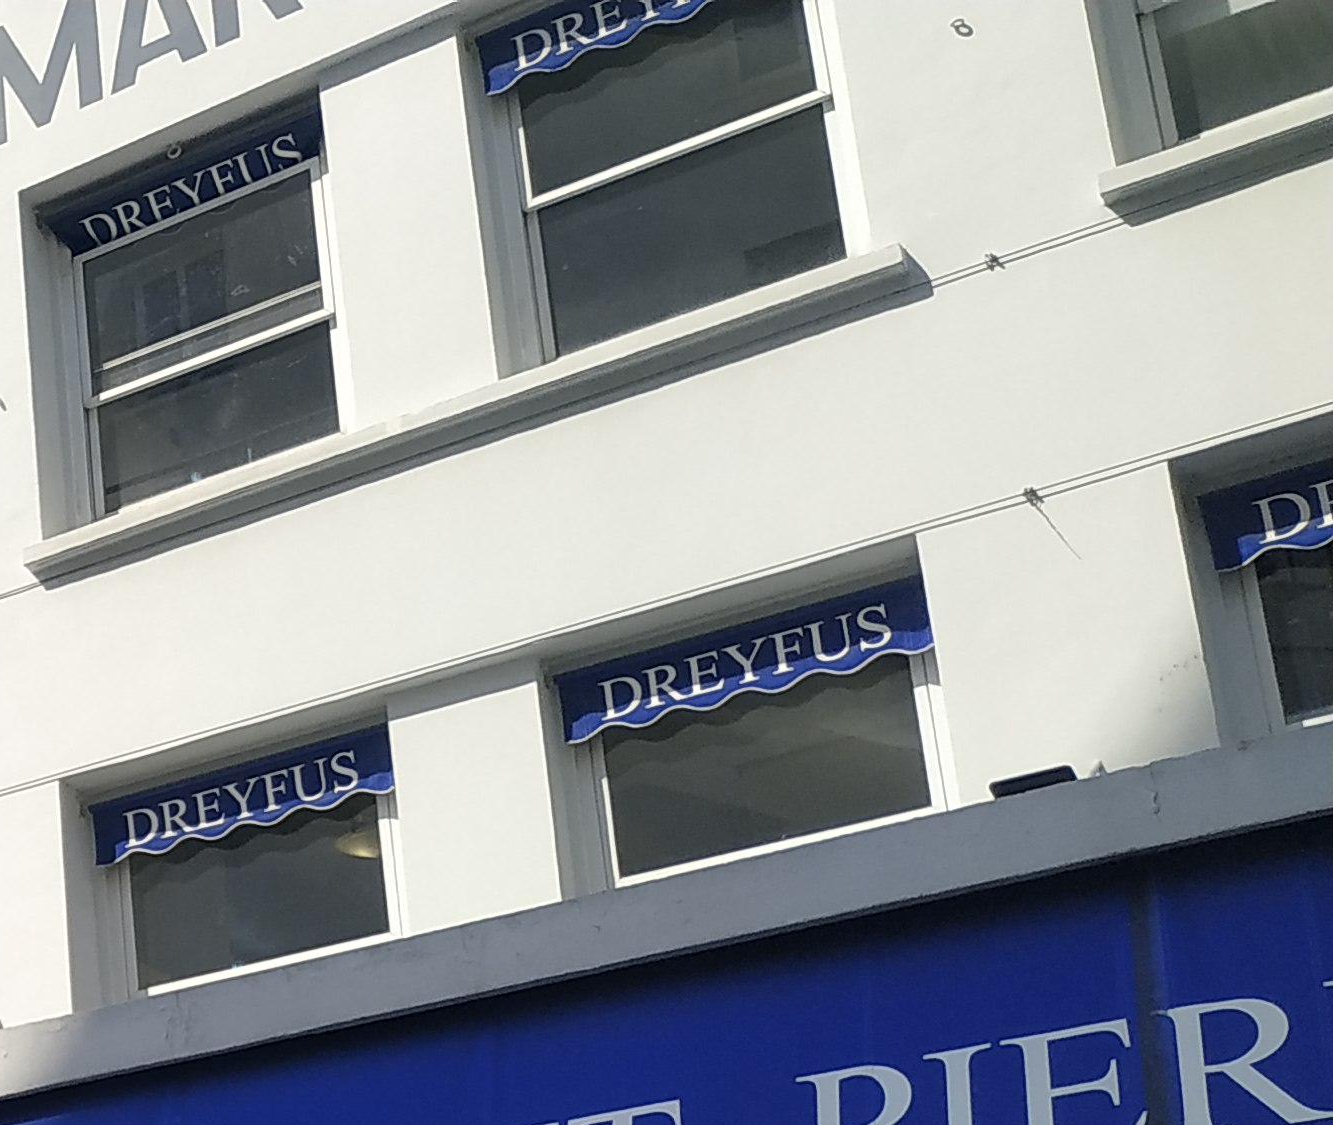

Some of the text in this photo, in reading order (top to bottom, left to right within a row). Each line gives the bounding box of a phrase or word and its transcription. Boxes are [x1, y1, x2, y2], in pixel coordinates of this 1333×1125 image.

[79, 132, 303, 249] DREYFUS
[598, 603, 893, 723] DREYFUS
[122, 749, 360, 850] DREYFUS
